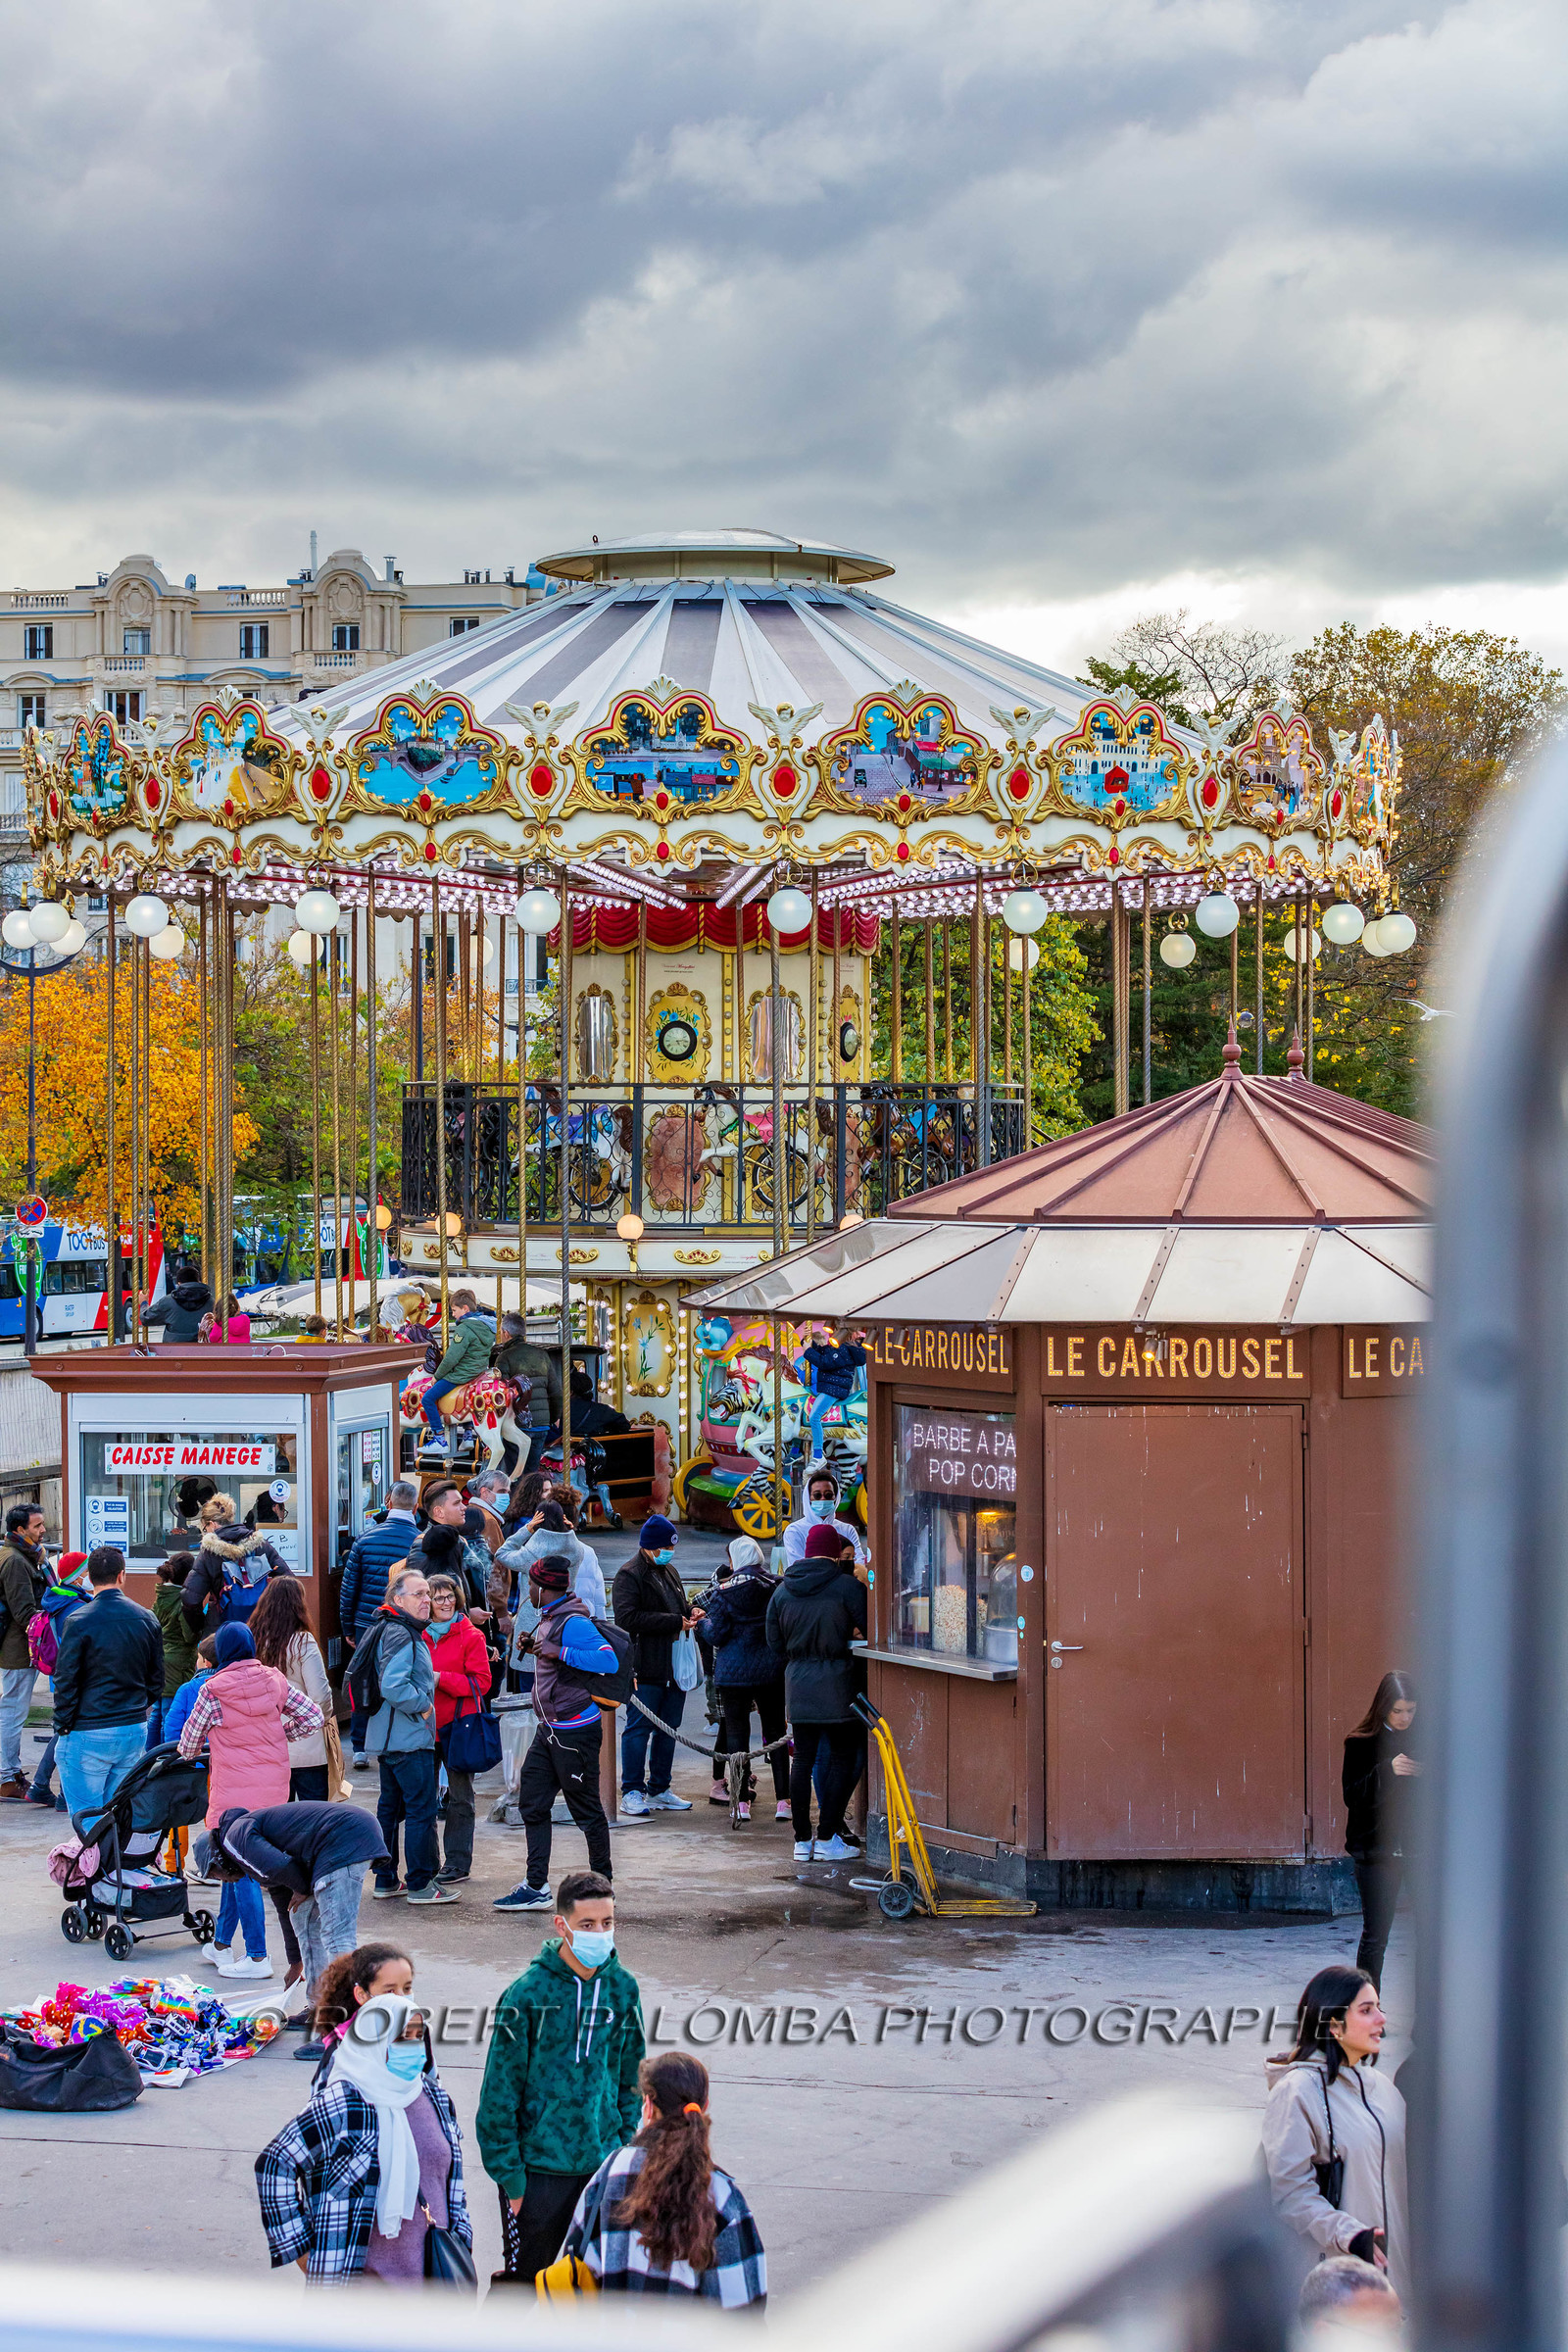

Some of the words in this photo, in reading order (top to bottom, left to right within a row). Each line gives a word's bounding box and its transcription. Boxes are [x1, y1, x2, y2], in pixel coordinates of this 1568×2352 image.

[875, 1327, 894, 1364] LE
[1048, 1337, 1085, 1377] LE
[1349, 1338, 1379, 1378] LE
[1391, 1337, 1425, 1377] CA
[913, 1424, 971, 1452] BARBE
[977, 1430, 989, 1454] A
[112, 1446, 175, 1465] CAISSE
[180, 1446, 262, 1466] MANEGE
[929, 1458, 965, 1485] POP
